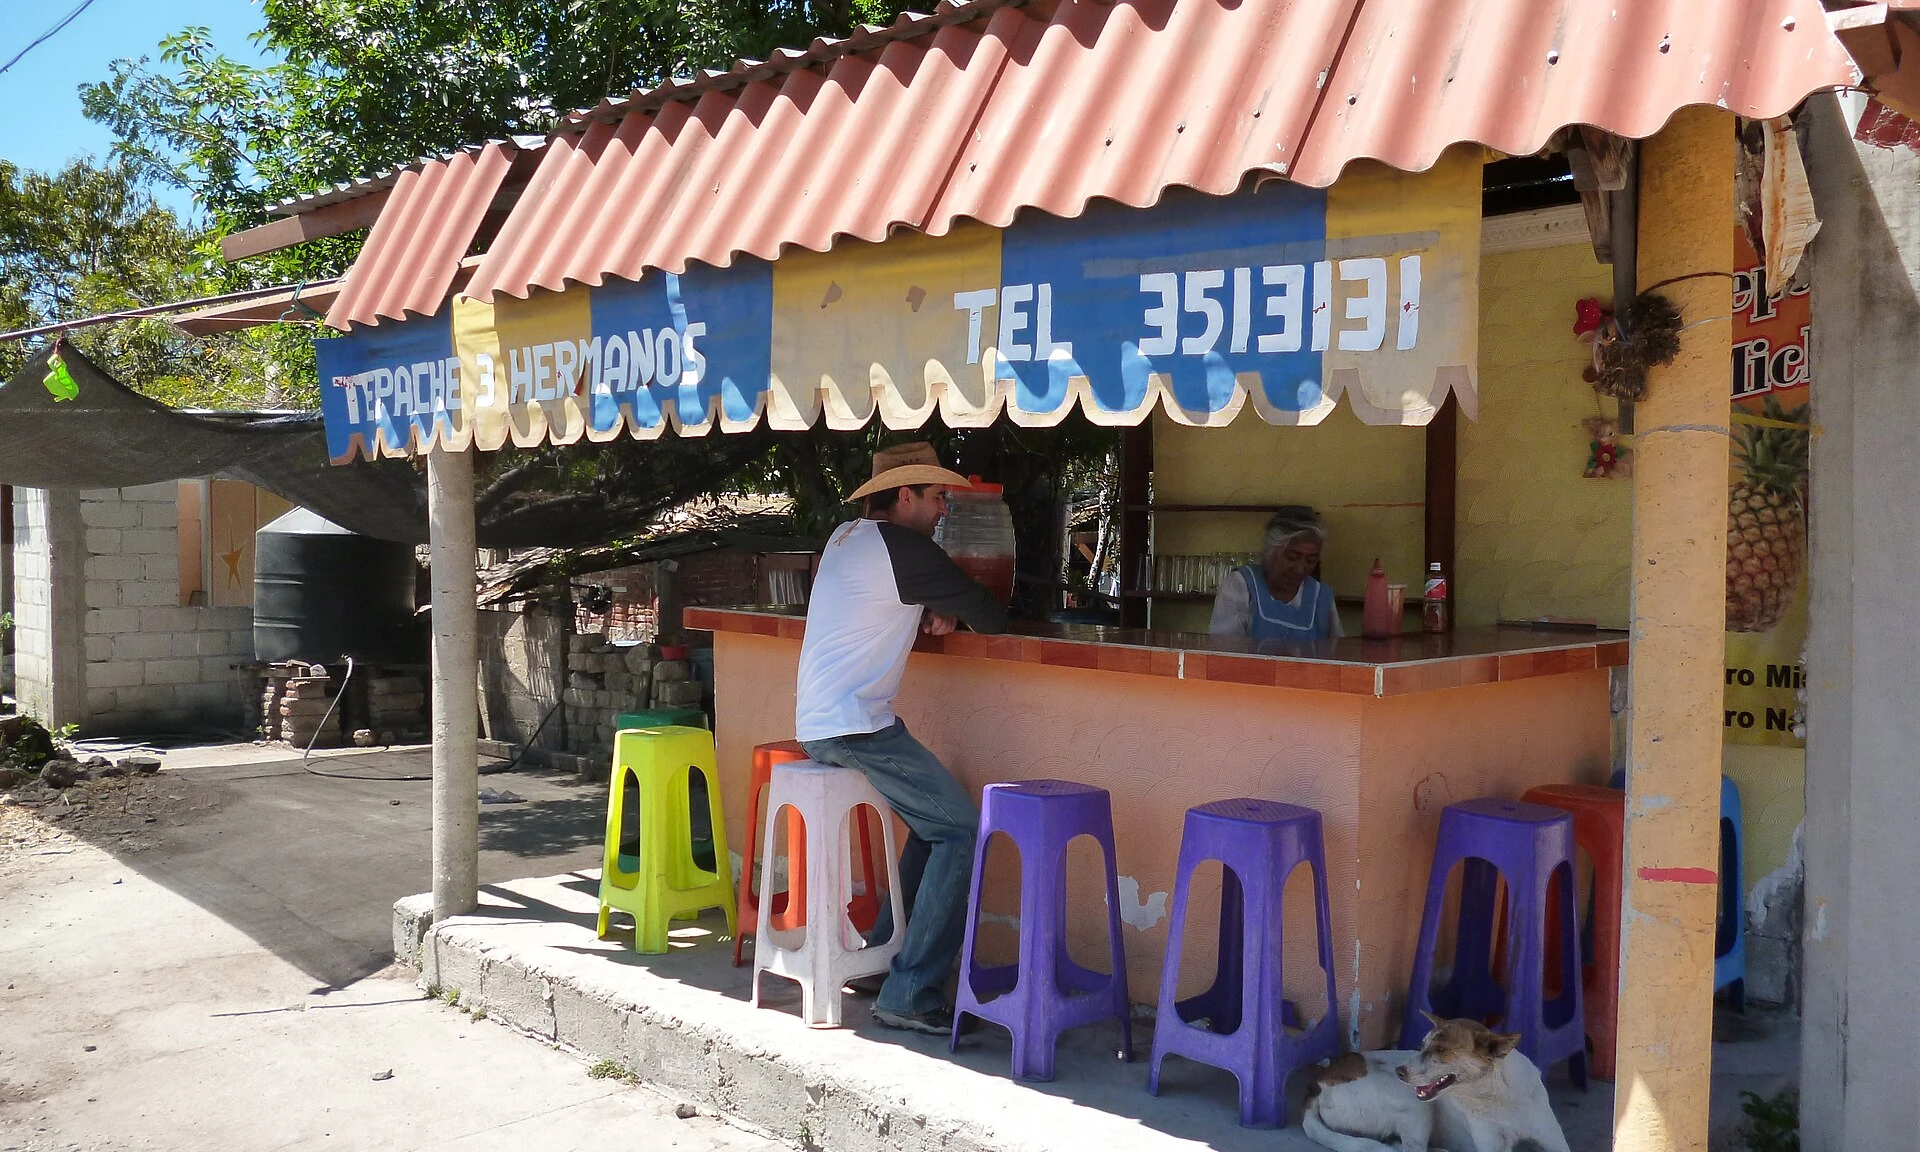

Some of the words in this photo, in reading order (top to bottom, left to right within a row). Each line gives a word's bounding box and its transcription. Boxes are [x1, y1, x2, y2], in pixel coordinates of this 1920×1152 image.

[953, 282, 1073, 365] TEL
[1137, 255, 1422, 356] 3513131
[332, 356, 462, 425] TEPACHE
[475, 353, 496, 408] 3
[509, 322, 706, 404] HERMANOS
